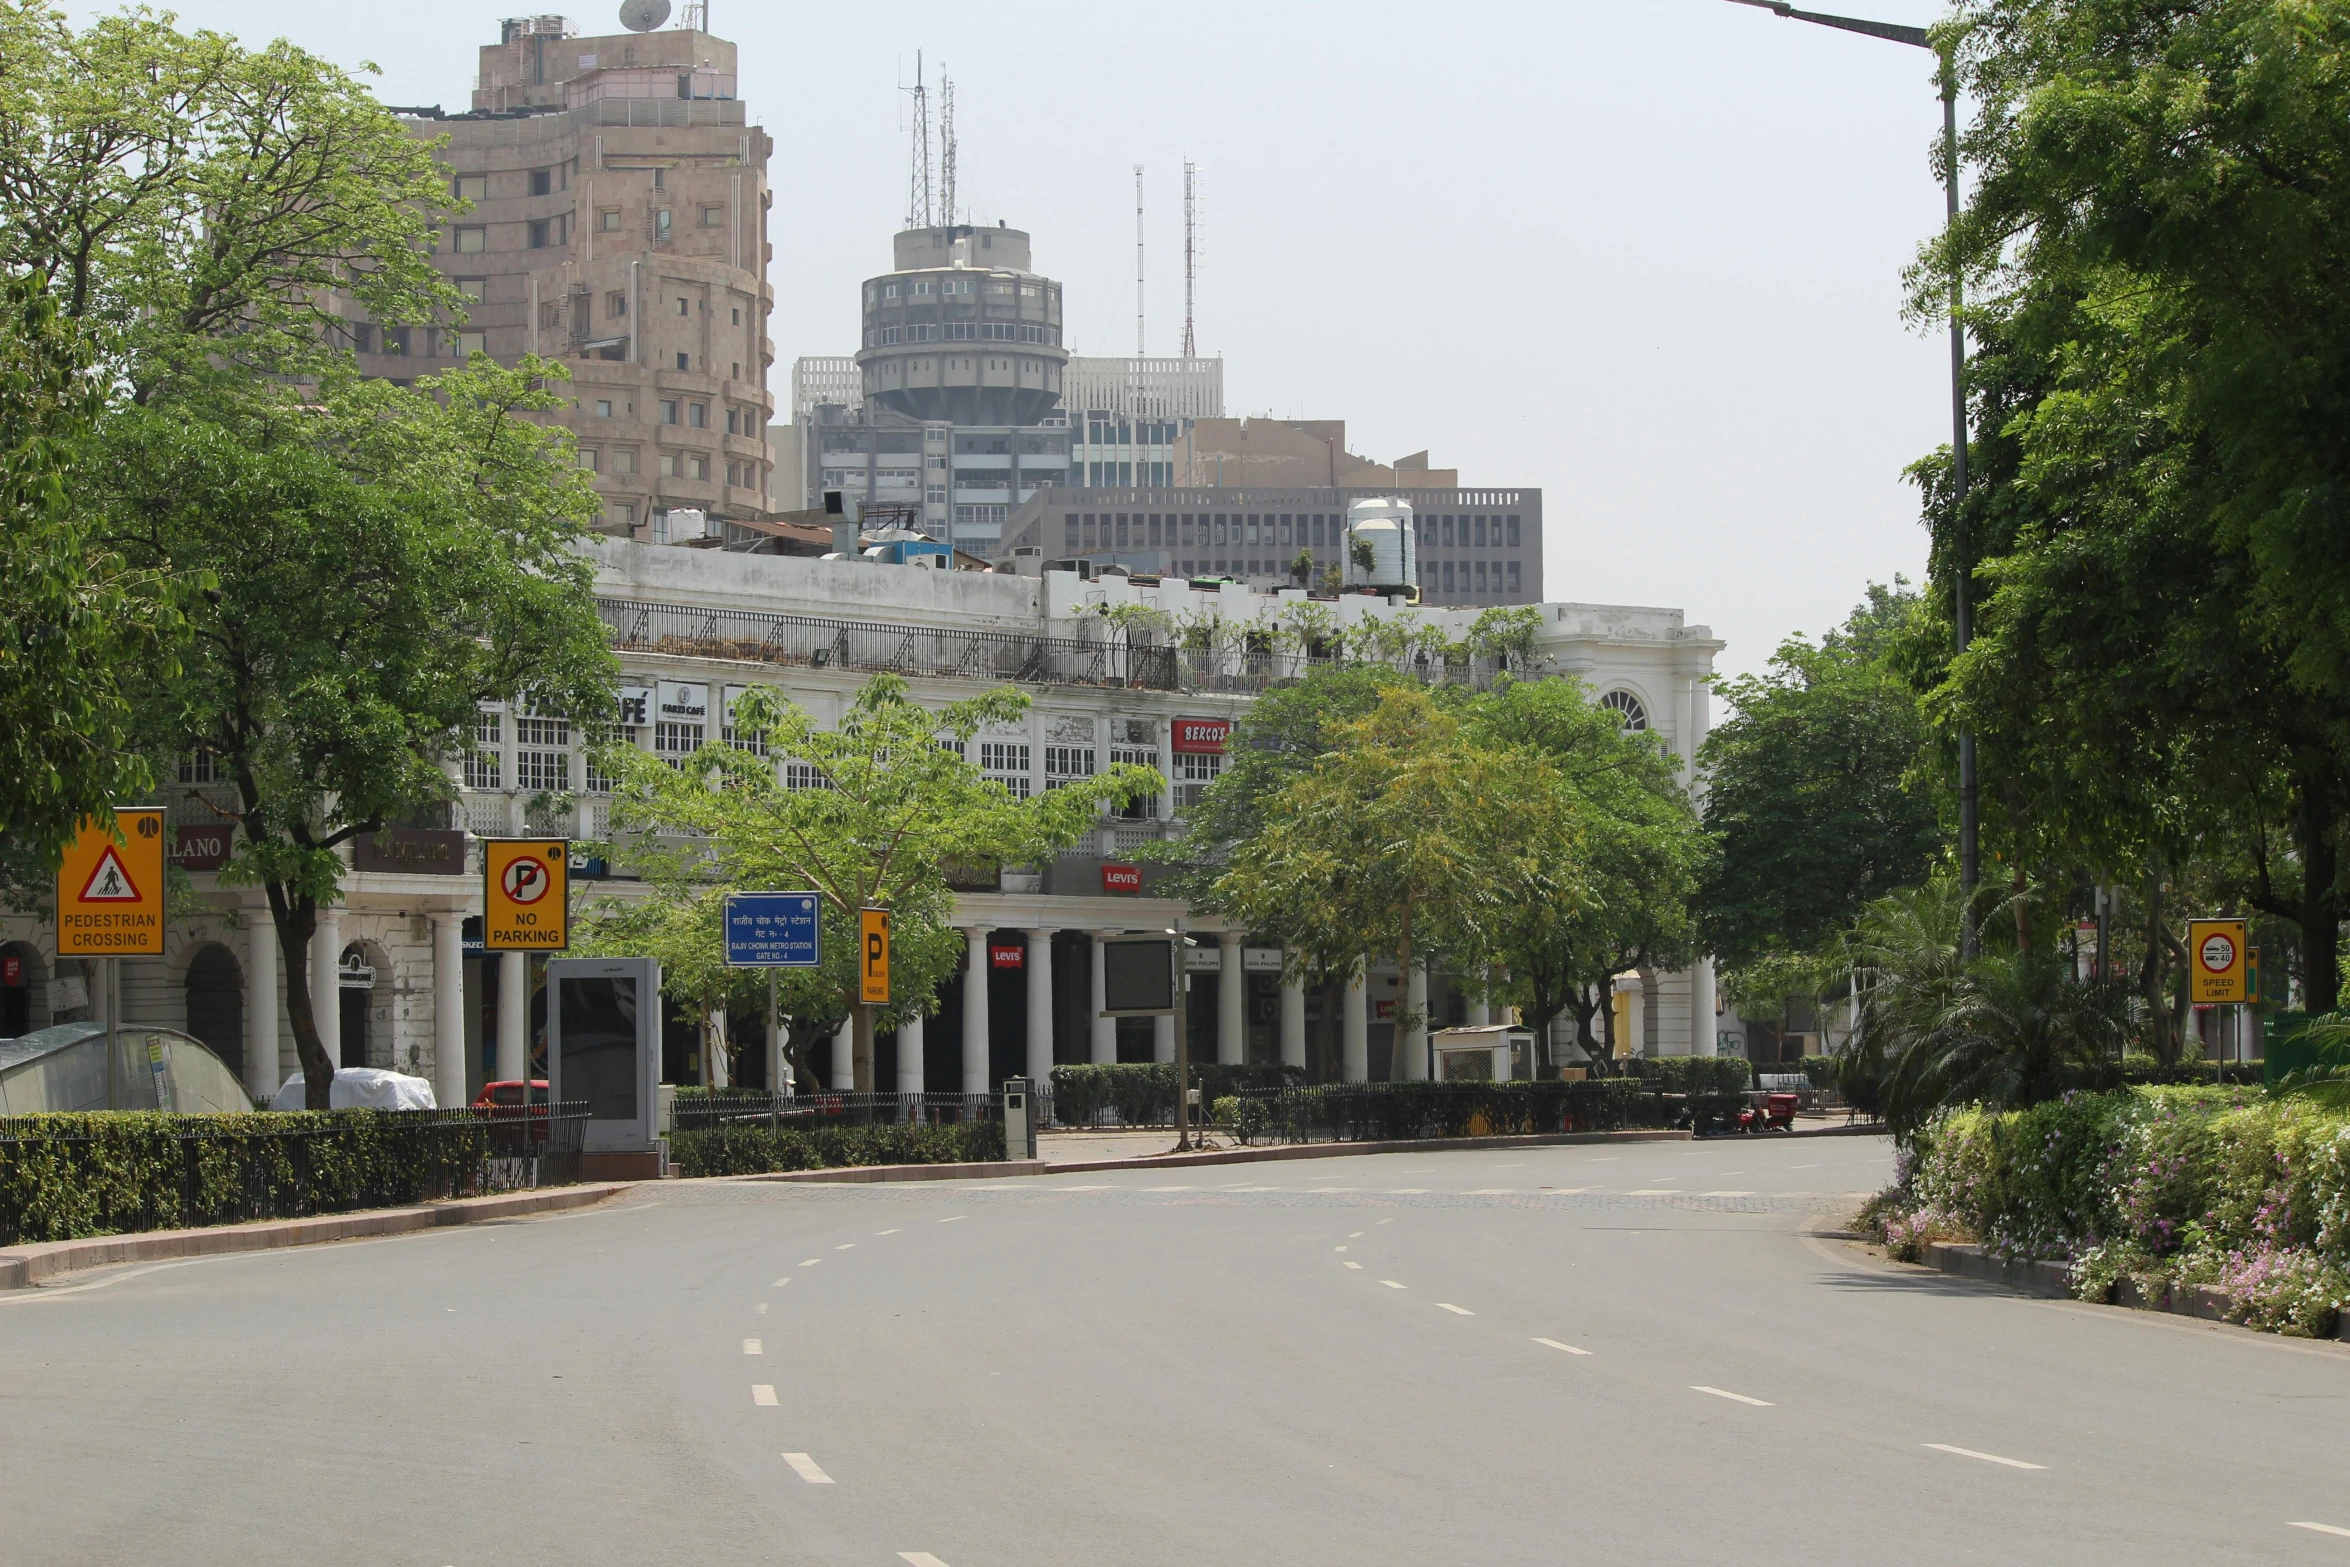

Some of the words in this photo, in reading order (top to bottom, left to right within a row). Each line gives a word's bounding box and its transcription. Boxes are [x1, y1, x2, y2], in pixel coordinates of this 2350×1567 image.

[662, 703, 685, 713] FARZI
[686, 705, 706, 716] CAFÉ
[1185, 726, 1226, 741] BERCO'S
[64, 914, 156, 927] PEDESTRIAN
[515, 913, 537, 926] NO
[732, 915, 753, 925] राजीव
[756, 915, 771, 925] चौक
[790, 915, 811, 925] स्टेशन
[493, 930, 559, 943] PARKING
[754, 928, 766, 938] गेट
[72, 933, 148, 946] CROSSING
[731, 942, 747, 950] RAJIV
[748, 942, 769, 950] CHOWK
[769, 942, 789, 950] METRO
[789, 942, 812, 950] STATION
[756, 952, 771, 960] GATE
[867, 932, 883, 977] P
[2202, 978, 2234, 986] SPEED
[866, 986, 884, 996] PARKING
[2206, 989, 2230, 997] LIMIT
